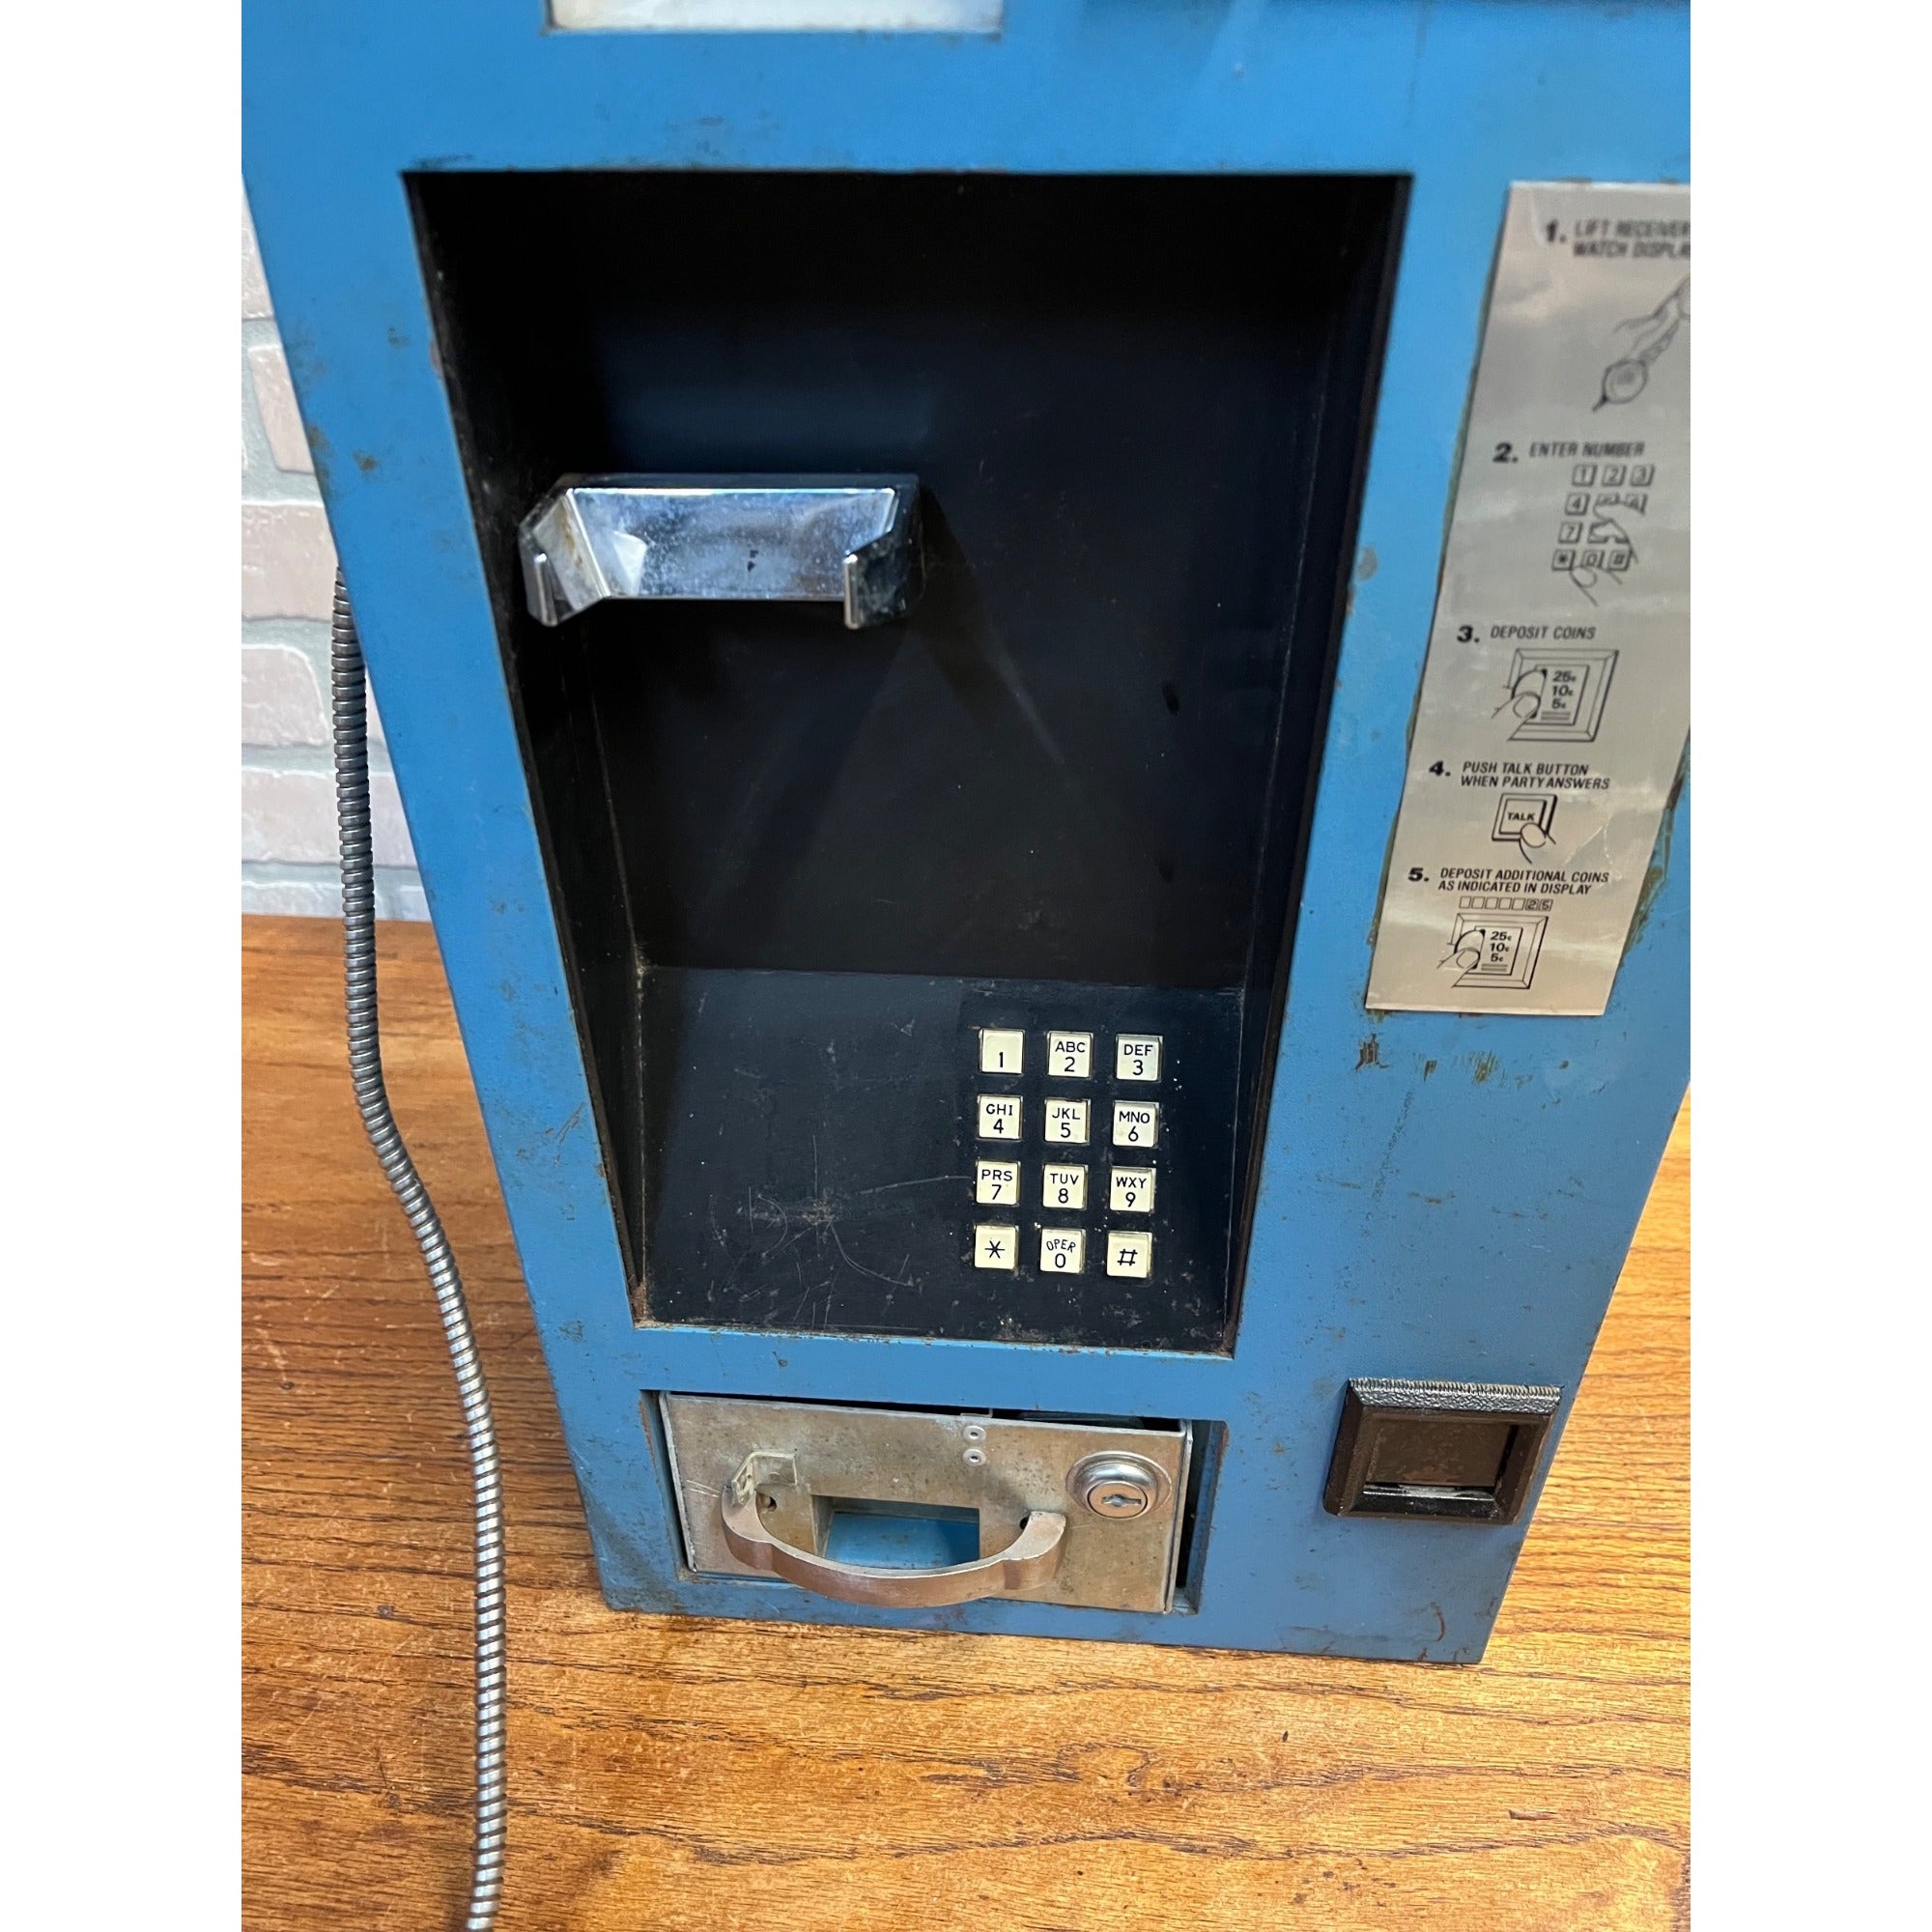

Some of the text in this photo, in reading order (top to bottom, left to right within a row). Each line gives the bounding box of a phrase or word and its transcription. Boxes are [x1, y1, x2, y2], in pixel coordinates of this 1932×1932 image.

[1547, 219, 1566, 242] 1.
[1493, 441, 1645, 463] 2. ENTER NUMBER
[1457, 625, 1596, 642] 3. DEPOSIT COINS
[1429, 760, 1589, 777] 4. PUSH TALK BUTTON
[1461, 776, 1609, 789] WHEN PARTY ANSWERS
[1507, 811, 1535, 821] TALK
[1408, 867, 1609, 883] 5. DEPOSIT ADDITIONAL COINS
[1438, 880, 1592, 895] AS INDICATED IN DISPLAY
[1055, 1041, 1086, 1053] ABC
[1123, 1044, 1153, 1056] DEF
[998, 1052, 1004, 1067] 1
[1064, 1057, 1075, 1072] 2
[1132, 1060, 1144, 1075] 3
[985, 1103, 1013, 1116] GHI
[1052, 1108, 1081, 1120] JKL
[1119, 1111, 1151, 1123] MNO
[993, 1118, 1005, 1134] 4
[1060, 1122, 1071, 1138] 5
[1128, 1125, 1139, 1142] 6
[980, 1169, 1013, 1181] PRS
[1050, 1173, 1079, 1185] TUV
[1116, 1176, 1148, 1189] WXY
[991, 1184, 1002, 1200] 7
[1058, 1188, 1069, 1204] 8
[1125, 1191, 1137, 1208] 9
[1045, 1238, 1077, 1253] OPER
[1054, 1253, 1066, 1269] 0
